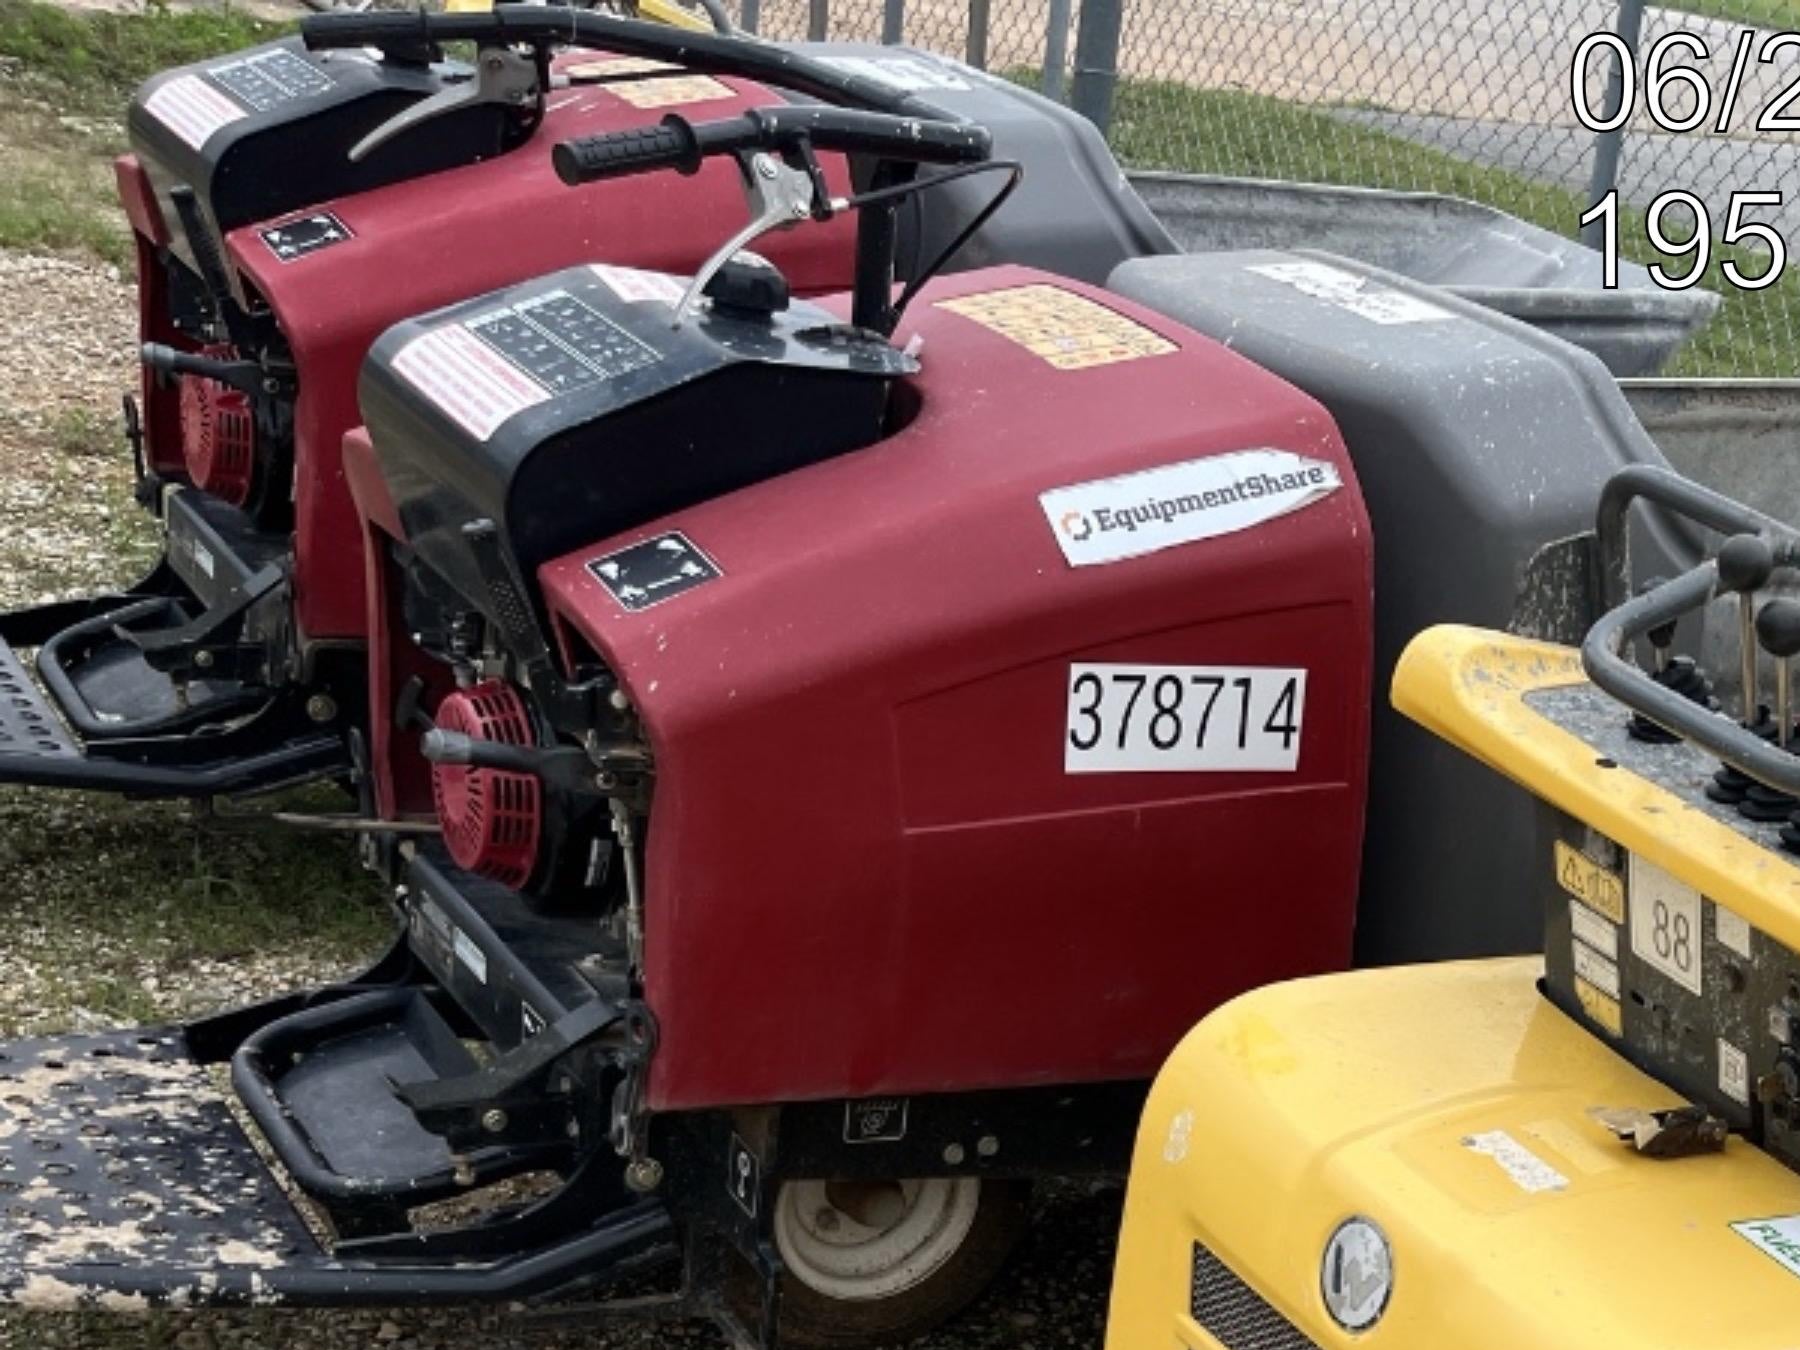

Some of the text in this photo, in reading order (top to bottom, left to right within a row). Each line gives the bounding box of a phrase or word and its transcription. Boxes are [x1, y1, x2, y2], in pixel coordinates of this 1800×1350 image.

[1092, 466, 1326, 533] EquipmentShare
[1069, 671, 1298, 751] 378714
[1652, 899, 1691, 973] 88
